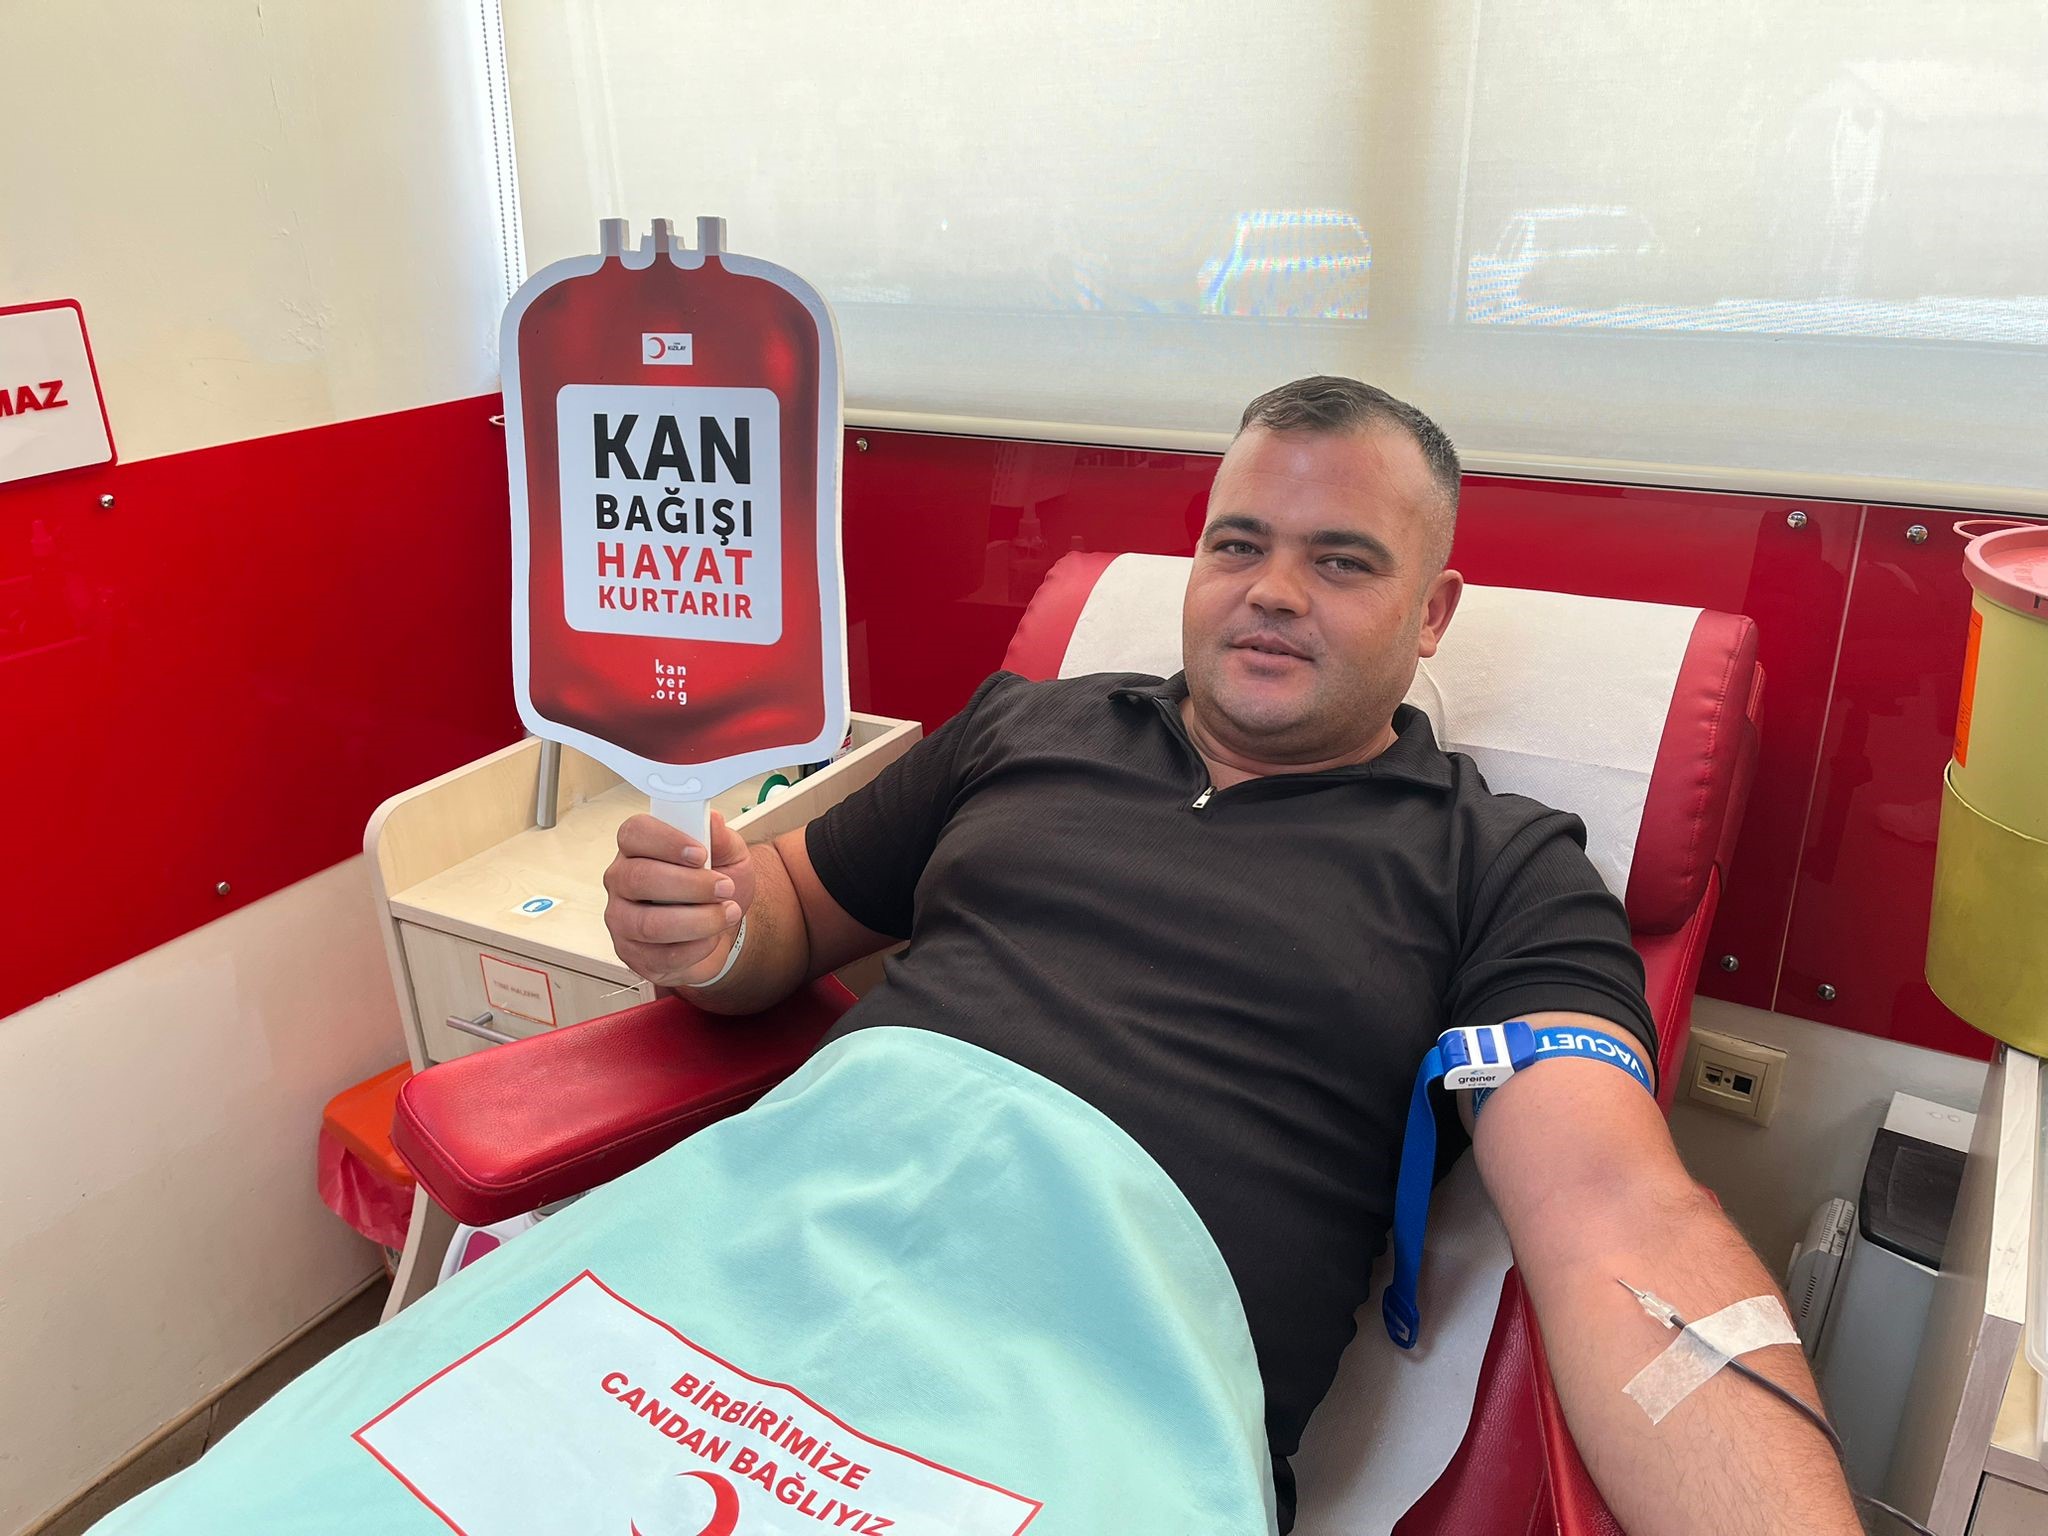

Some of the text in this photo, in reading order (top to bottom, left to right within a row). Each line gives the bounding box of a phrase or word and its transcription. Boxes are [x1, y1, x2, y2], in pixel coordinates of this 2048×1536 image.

[593, 413, 751, 485] KAN
[595, 487, 752, 546] BAĞIŞI
[597, 541, 752, 585] HAYAT
[598, 585, 752, 619] KURTARIR
[655, 659, 687, 676] kan
[655, 677, 686, 689] ver
[650, 689, 687, 705] .org
[1457, 1074, 1496, 1085] greiner
[670, 1372, 871, 1491] BİRBİRİMİZE
[600, 1371, 896, 1536] CANDAN BAĞLIYIZ
